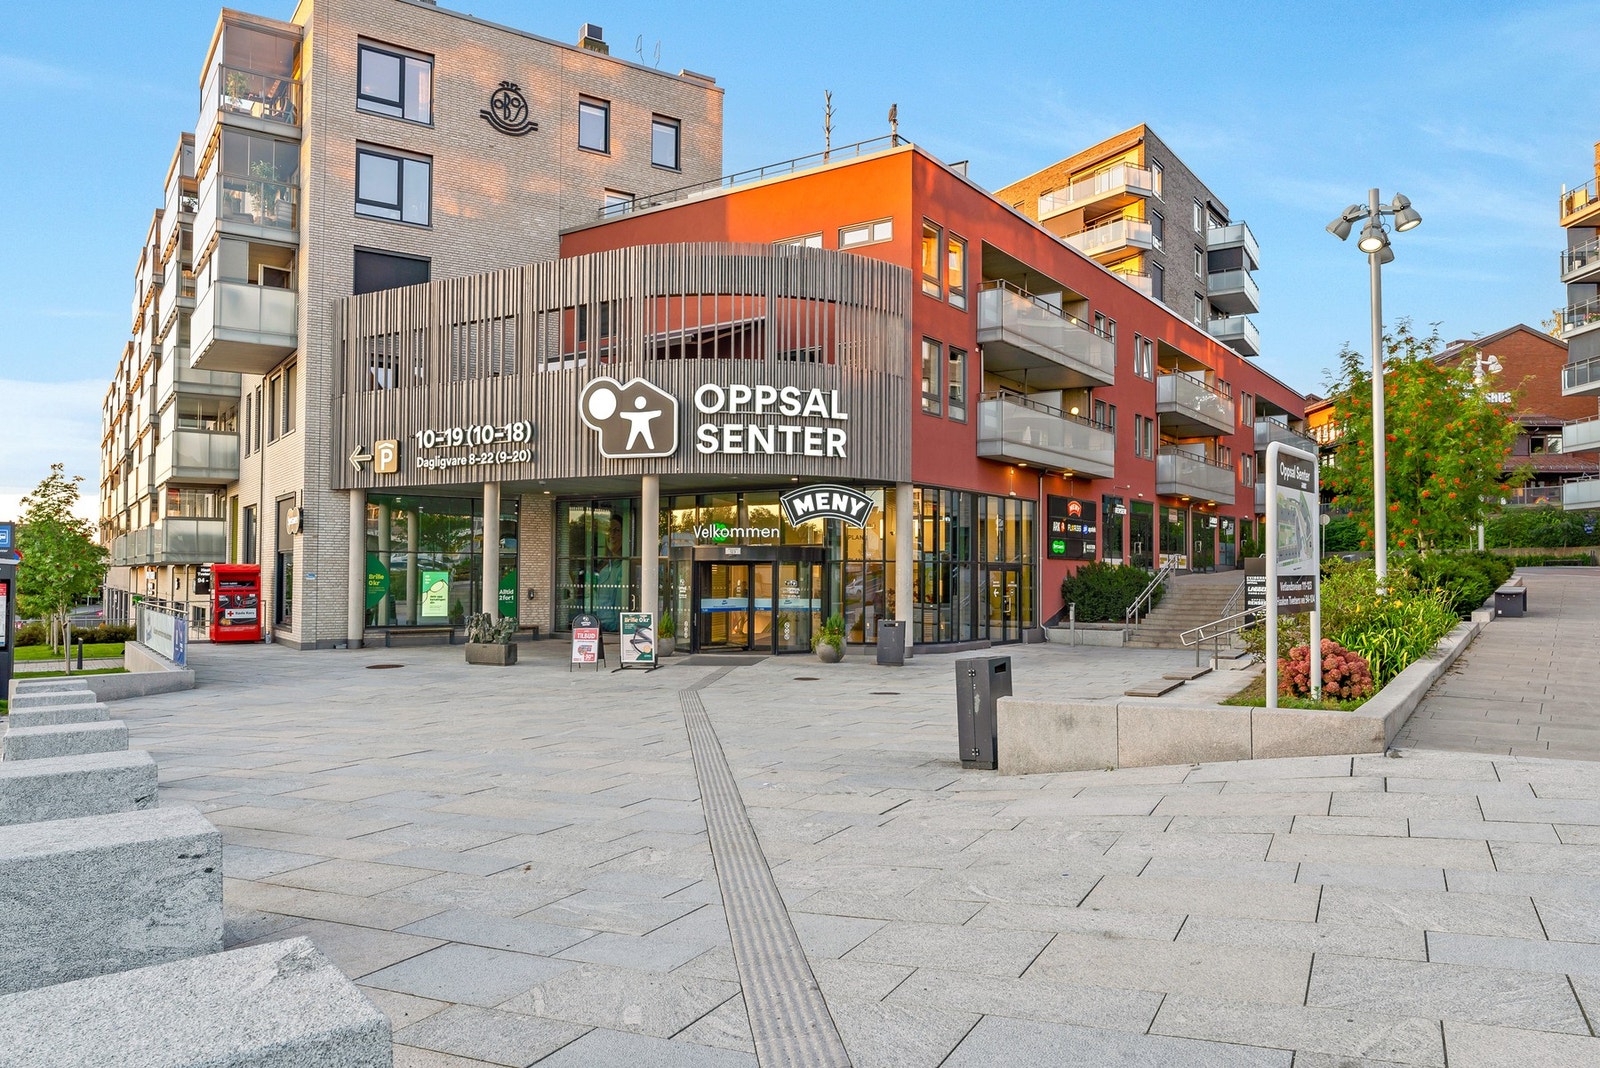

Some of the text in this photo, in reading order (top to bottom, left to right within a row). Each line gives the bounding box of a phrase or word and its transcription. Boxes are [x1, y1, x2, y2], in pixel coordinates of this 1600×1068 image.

[694, 383, 849, 420] OPPSAL
[415, 420, 532, 449] 10-19 (10-18)
[696, 424, 848, 458] SENTER
[416, 448, 532, 471] Dagligvare 8-22 (9-20)
[1280, 462, 1311, 482] Oppsal Senter
[792, 492, 866, 518] MENY
[693, 522, 781, 539] Velkommen
